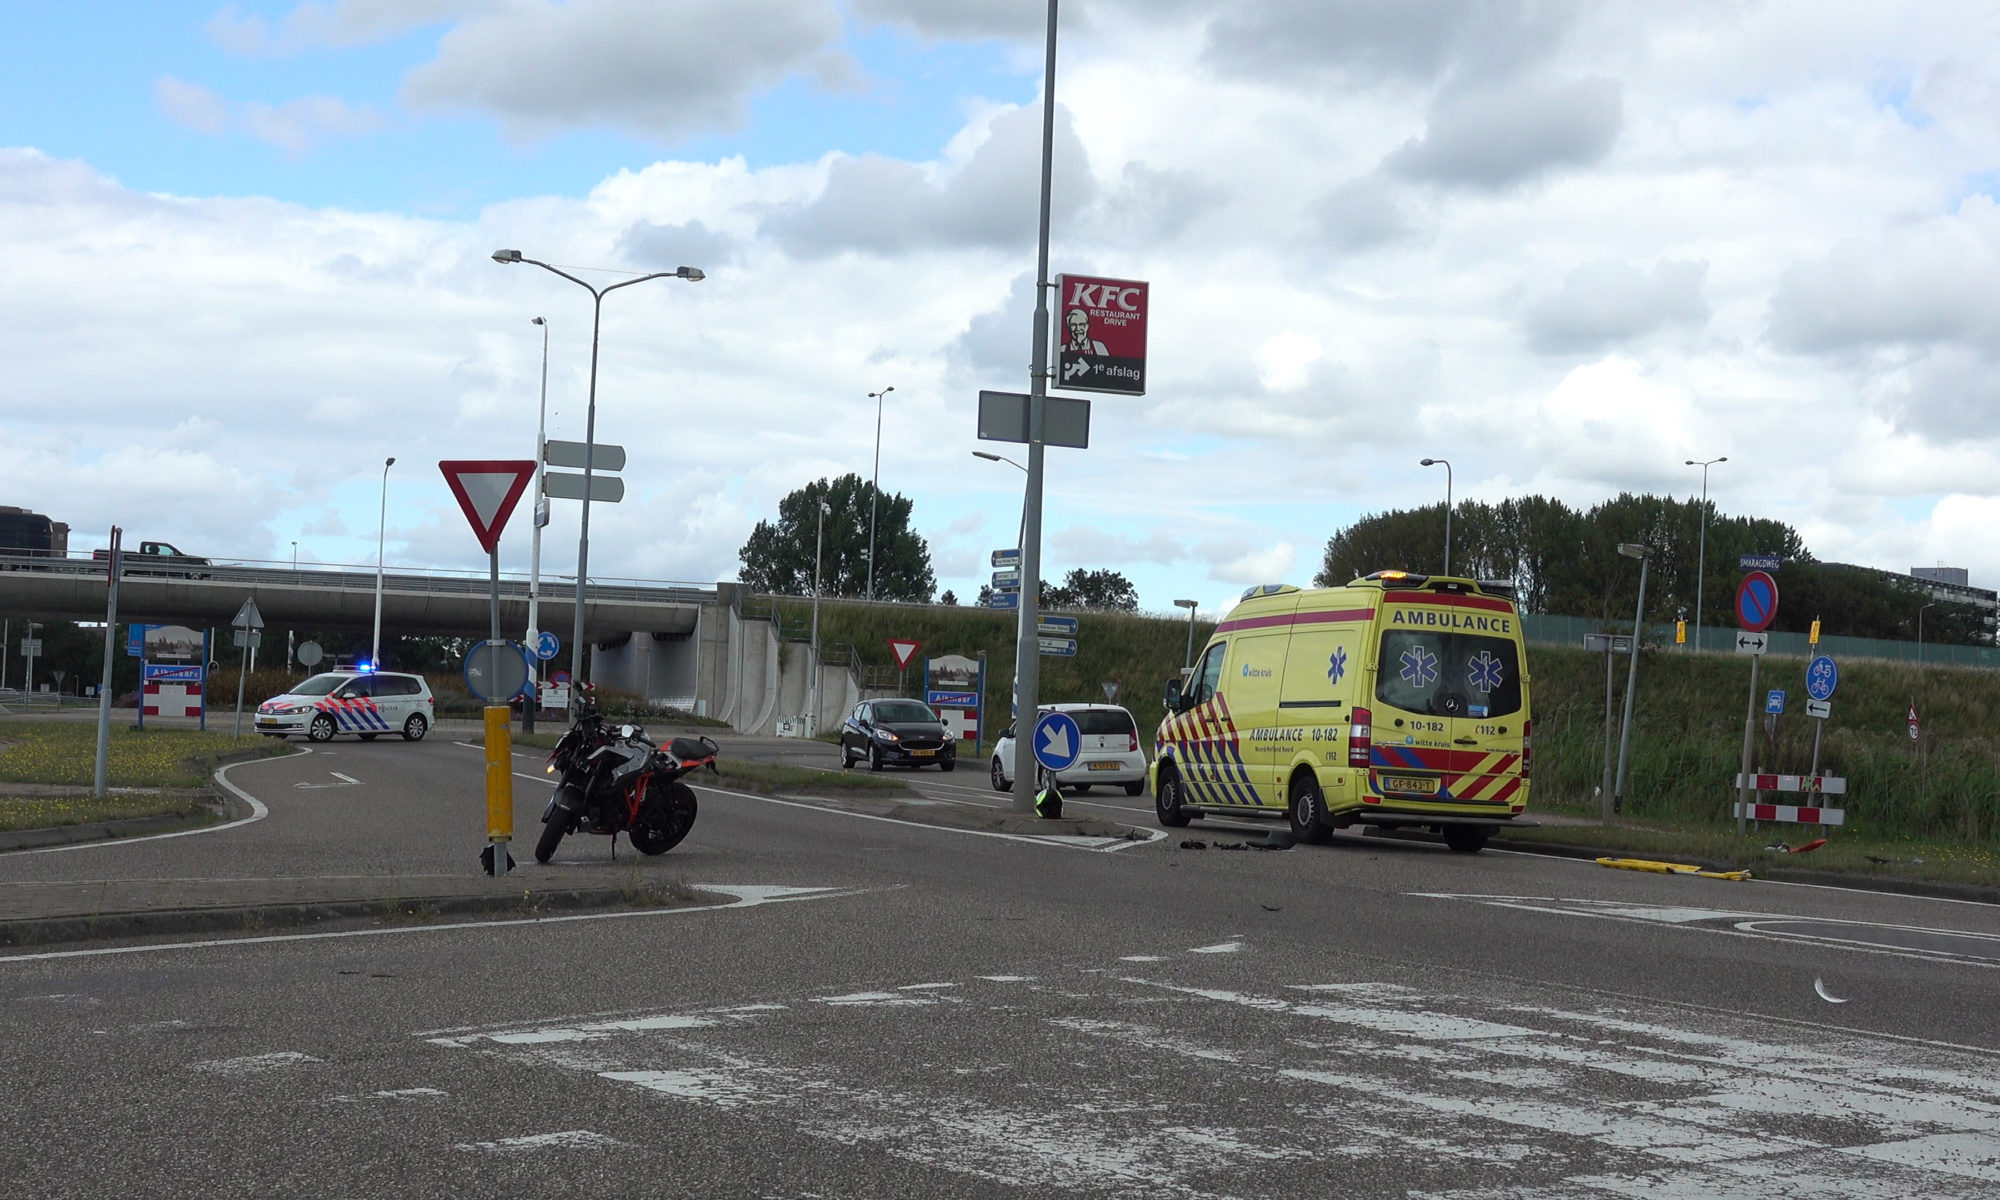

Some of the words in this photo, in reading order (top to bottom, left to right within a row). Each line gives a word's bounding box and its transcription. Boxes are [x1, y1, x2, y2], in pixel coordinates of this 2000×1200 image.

[1069, 282, 1140, 311] KFC
[1090, 309, 1141, 320] RESTAURANT
[1104, 318, 1127, 326] DRIVE
[1106, 366, 1140, 380] afslag
[1739, 558, 1779, 569] SMARAGDWEG
[1392, 610, 1511, 633] AMBULANCE
[152, 668, 194, 677] Alkmaar
[1248, 669, 1261, 677] witte
[1261, 667, 1272, 677] kruis
[935, 694, 971, 703] Alkmaar
[1410, 720, 1444, 732] 10-182
[1480, 725, 1496, 736] 112
[1249, 728, 1303, 741] AMBULANCE
[1312, 728, 1338, 741] 10-182
[1415, 739, 1433, 747] witte
[1434, 739, 1450, 748] kruis
[1392, 777, 1430, 790] GF-843-T
